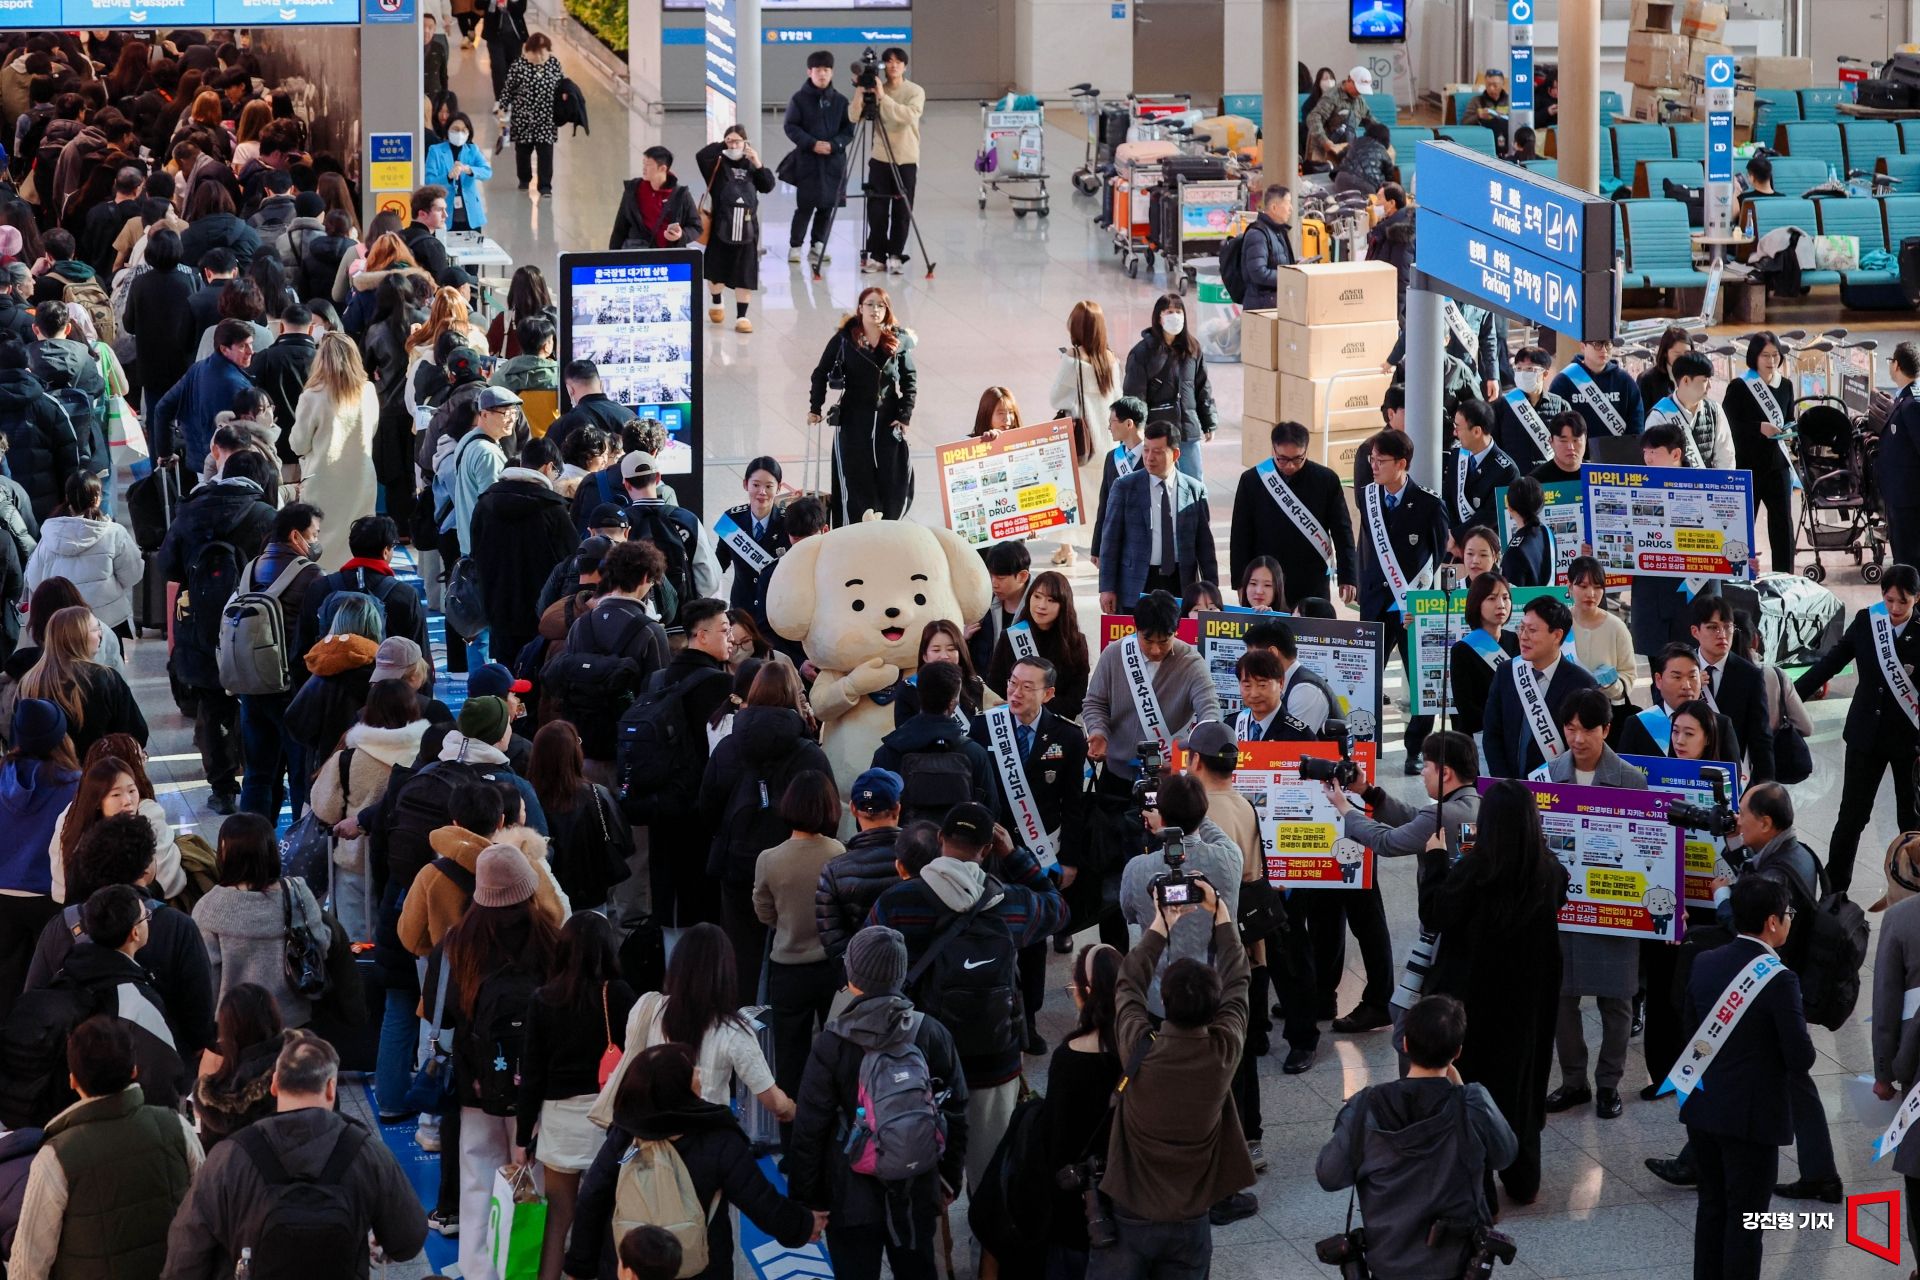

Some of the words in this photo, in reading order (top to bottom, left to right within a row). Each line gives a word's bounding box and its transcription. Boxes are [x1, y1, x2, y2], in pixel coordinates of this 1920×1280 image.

[0, 0, 33, 10] ssport
[1492, 209, 1520, 235] Arrivals
[1524, 204, 1542, 235] 도착
[1482, 270, 1510, 303] Parking
[1514, 266, 1542, 304] 주차장
[989, 505, 1016, 517] DRUGS
[1638, 540, 1672, 548] DRUGS
[1270, 760, 1300, 768] 마약으로부
[1627, 809, 1644, 817] 지키는
[1267, 860, 1286, 868] 신고는
[1288, 860, 1316, 868] 국번없이
[1318, 860, 1332, 868] 125
[1288, 870, 1302, 878] 최대
[1302, 870, 1322, 878] 3억원
[1576, 904, 1597, 914] 신고는
[1598, 906, 1626, 916] 국번없이
[1628, 908, 1644, 917] 125
[1576, 914, 1596, 924] 포상금
[1598, 916, 1612, 925] 최대
[1614, 918, 1634, 926] 3억원
